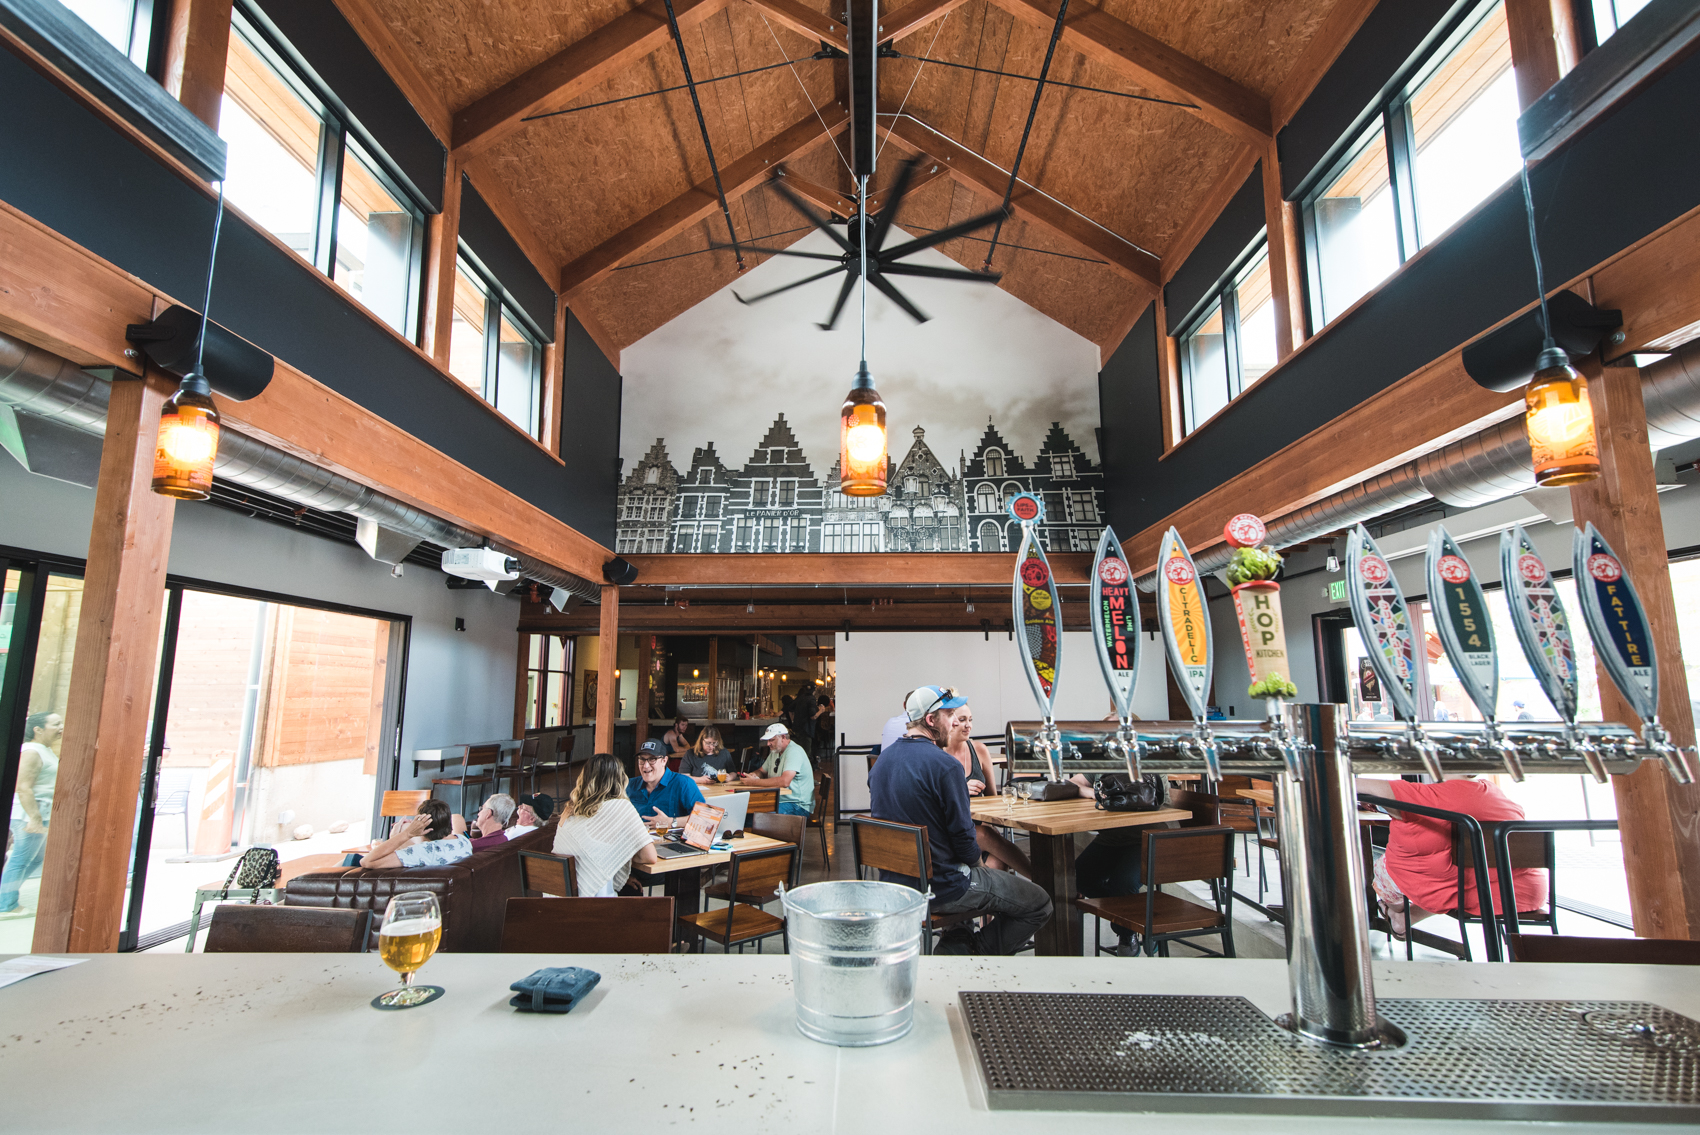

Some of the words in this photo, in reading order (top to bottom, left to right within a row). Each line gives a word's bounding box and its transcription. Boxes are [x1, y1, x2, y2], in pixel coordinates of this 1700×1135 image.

[1102, 587, 1129, 596] HEAVY
[1331, 581, 1346, 600] EXIT
[1102, 600, 1114, 648] WATERMELON
[1108, 597, 1129, 669] MELON
[1125, 615, 1134, 632] LIME
[1179, 587, 1198, 663] CITRADELIC
[1254, 595, 1275, 645] HOP
[1455, 587, 1481, 647] 1554
[1607, 585, 1624, 617] FAT
[1618, 620, 1641, 665] TIRE
[1256, 649, 1284, 658] KITCHEN
[1189, 670, 1204, 678] IPA
[1633, 669, 1649, 677] ALE
